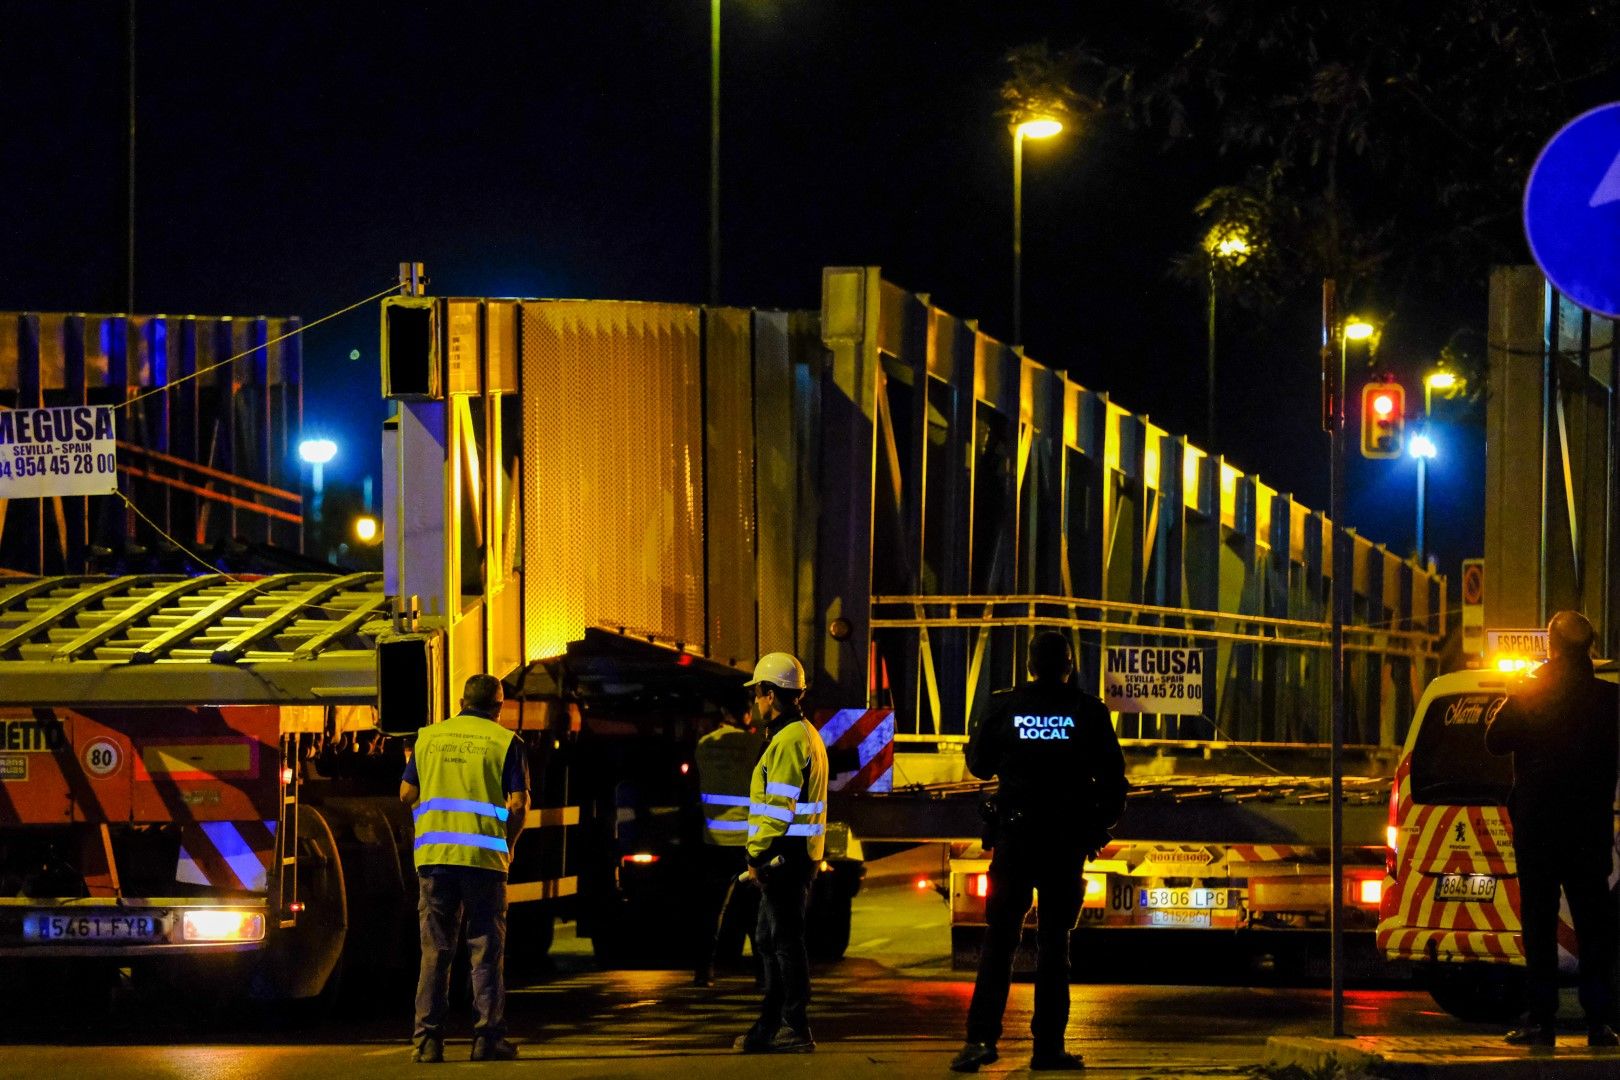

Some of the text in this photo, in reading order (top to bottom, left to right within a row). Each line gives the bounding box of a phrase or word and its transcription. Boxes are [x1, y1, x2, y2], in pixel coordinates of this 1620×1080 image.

[0, 407, 114, 445] MEGUSA
[13, 445, 53, 456] SEVILLA
[62, 443, 92, 454] SPAIN
[15, 456, 46, 477] 954
[50, 455, 70, 475] 45
[74, 454, 93, 474] 28
[97, 453, 115, 474] 00
[1498, 635, 1547, 653] ESPECIAL
[1107, 648, 1201, 675] MEGUSA
[1125, 674, 1154, 683] SEVILLA
[1161, 675, 1184, 684] SPAIN
[1126, 683, 1148, 698] 954
[1151, 684, 1166, 699] 45
[1169, 684, 1184, 699] 28
[1187, 684, 1201, 699] 00
[1014, 715, 1075, 728] POLICIA
[0, 721, 64, 750] ETTO
[1019, 728, 1069, 740] LOCAL
[92, 749, 112, 767] 80
[1112, 884, 1133, 911] 80
[1150, 892, 1224, 906] 5806 LPG
[52, 918, 148, 937] 5461 FYR
